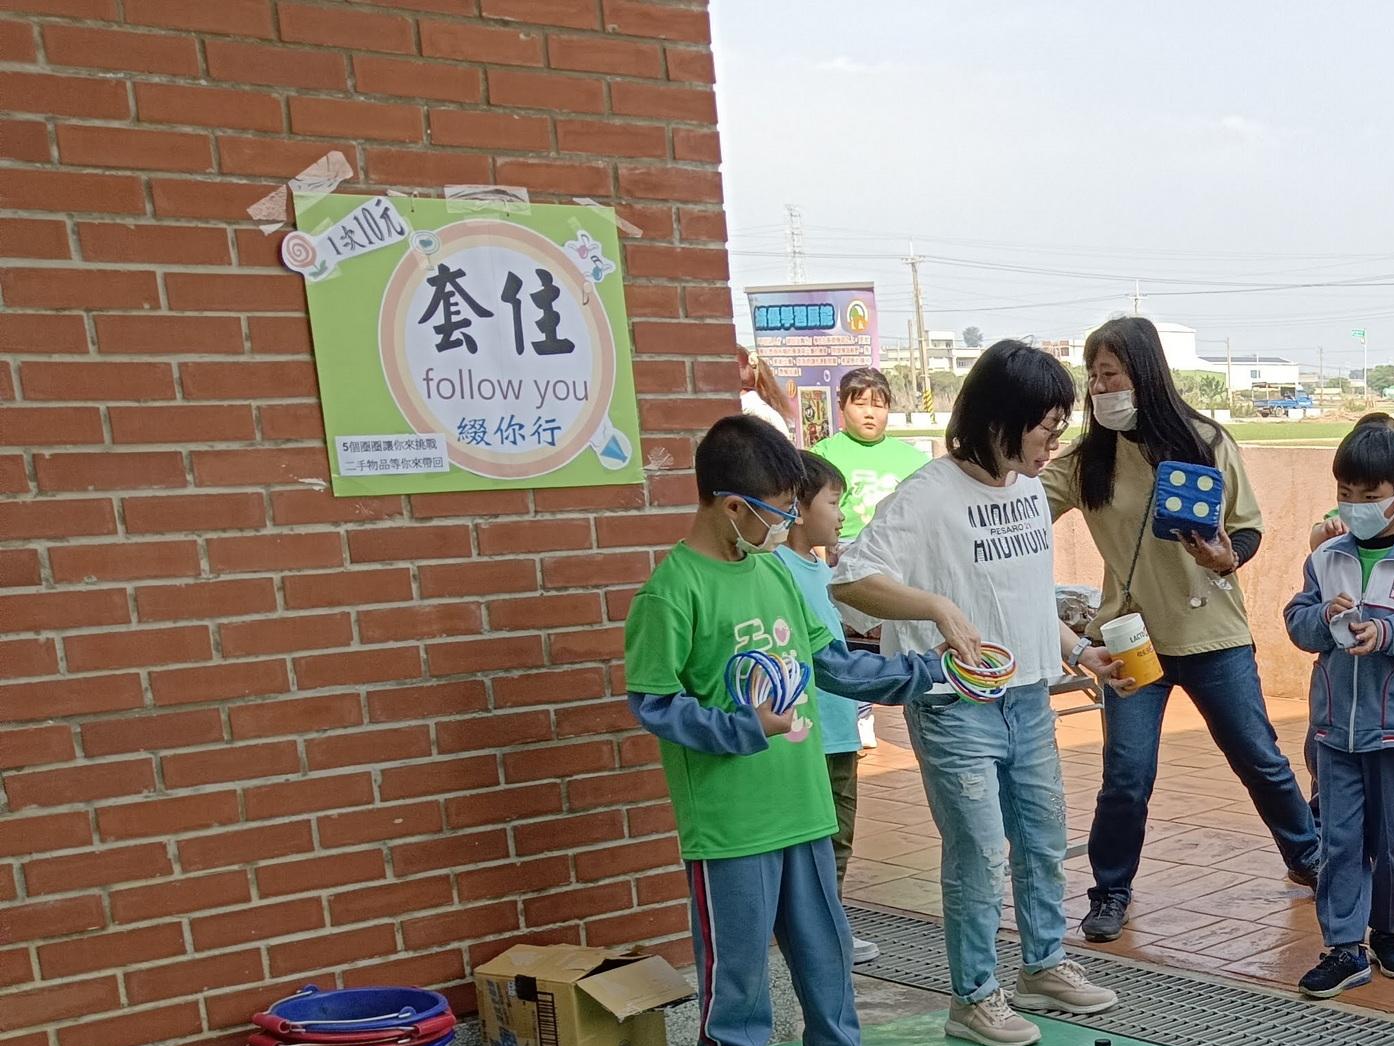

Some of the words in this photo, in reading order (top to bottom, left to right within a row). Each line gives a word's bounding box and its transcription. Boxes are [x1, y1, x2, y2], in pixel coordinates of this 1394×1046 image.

[327, 198, 406, 256] 1次10元
[418, 263, 576, 356] 套住
[423, 368, 524, 401] follow
[533, 378, 589, 409] you
[343, 438, 438, 453] 5個圈圈讓你來挑戰
[457, 415, 562, 448] 綴你行
[345, 456, 444, 472] 二手物品等你來帶回
